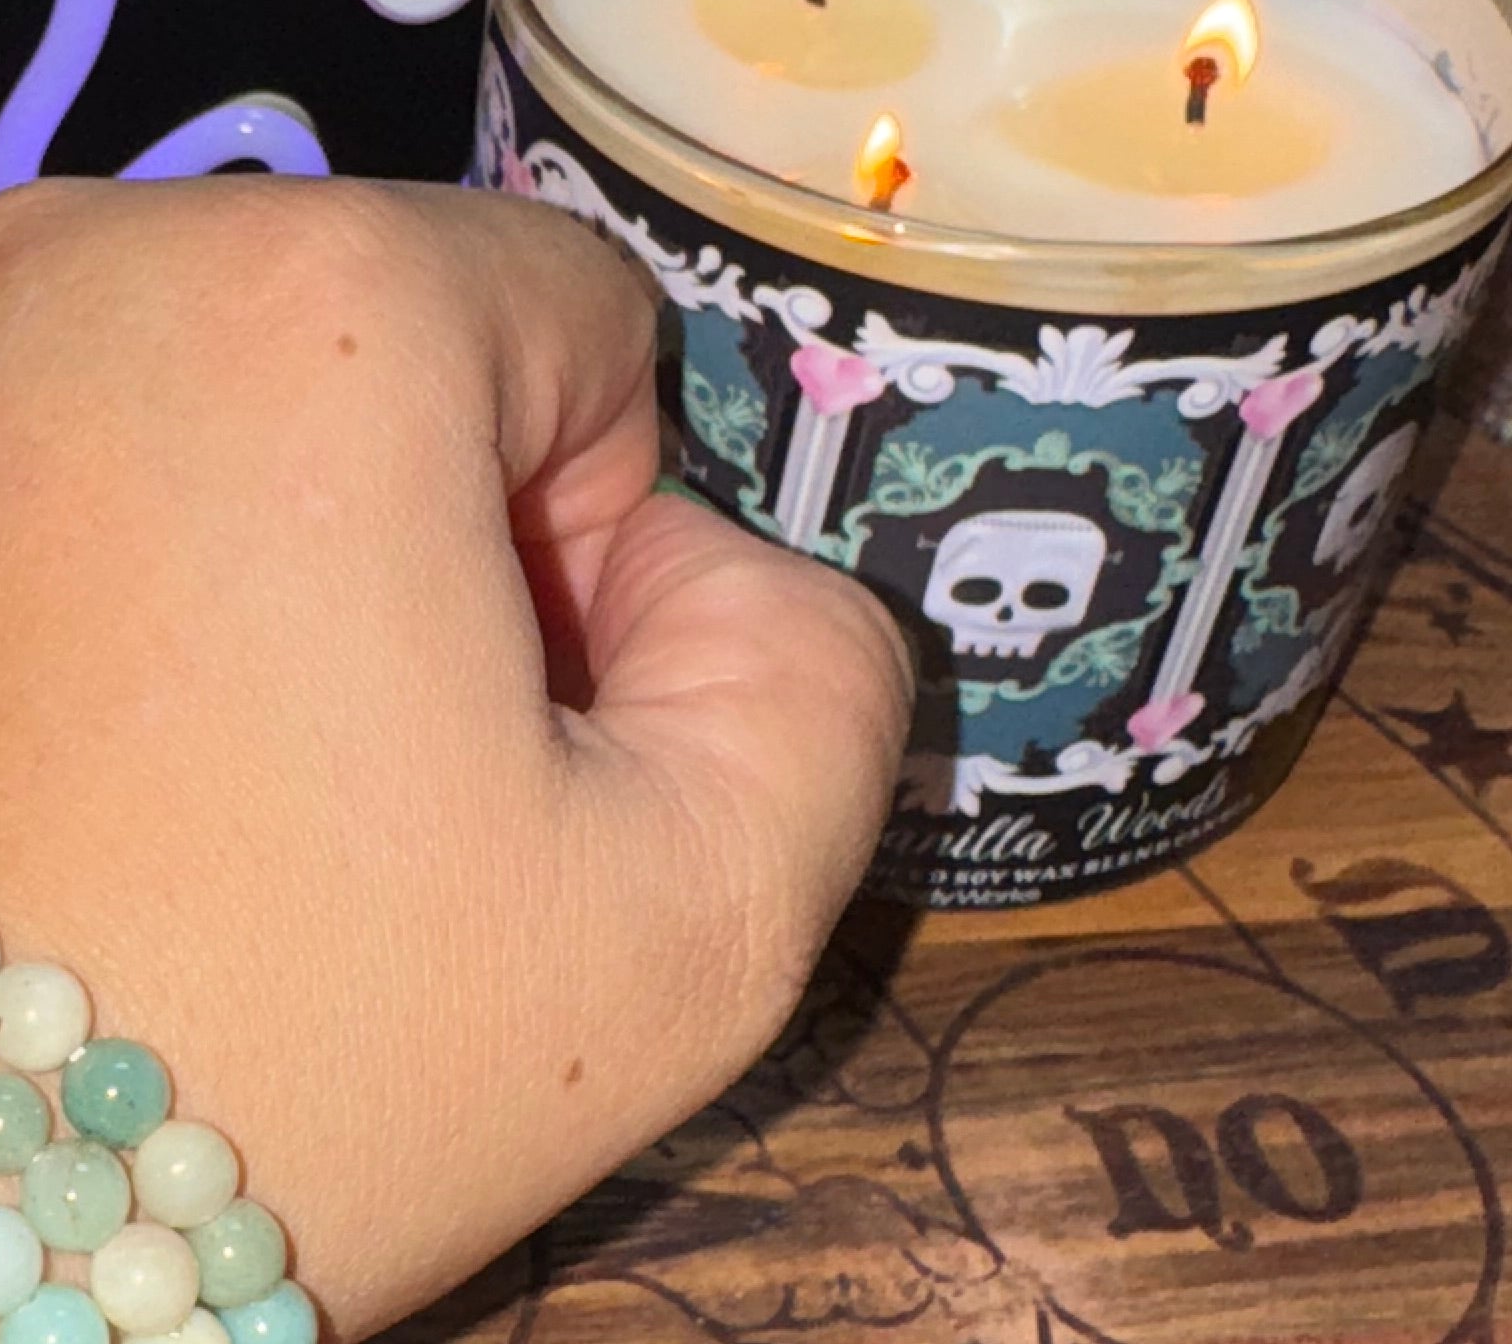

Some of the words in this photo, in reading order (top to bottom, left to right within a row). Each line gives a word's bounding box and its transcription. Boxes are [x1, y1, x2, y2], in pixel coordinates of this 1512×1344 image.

[885, 811, 1057, 863] anilla
[1076, 764, 1230, 852] Woods
[954, 868, 1008, 886] SOY
[1012, 859, 1078, 884] WAX
